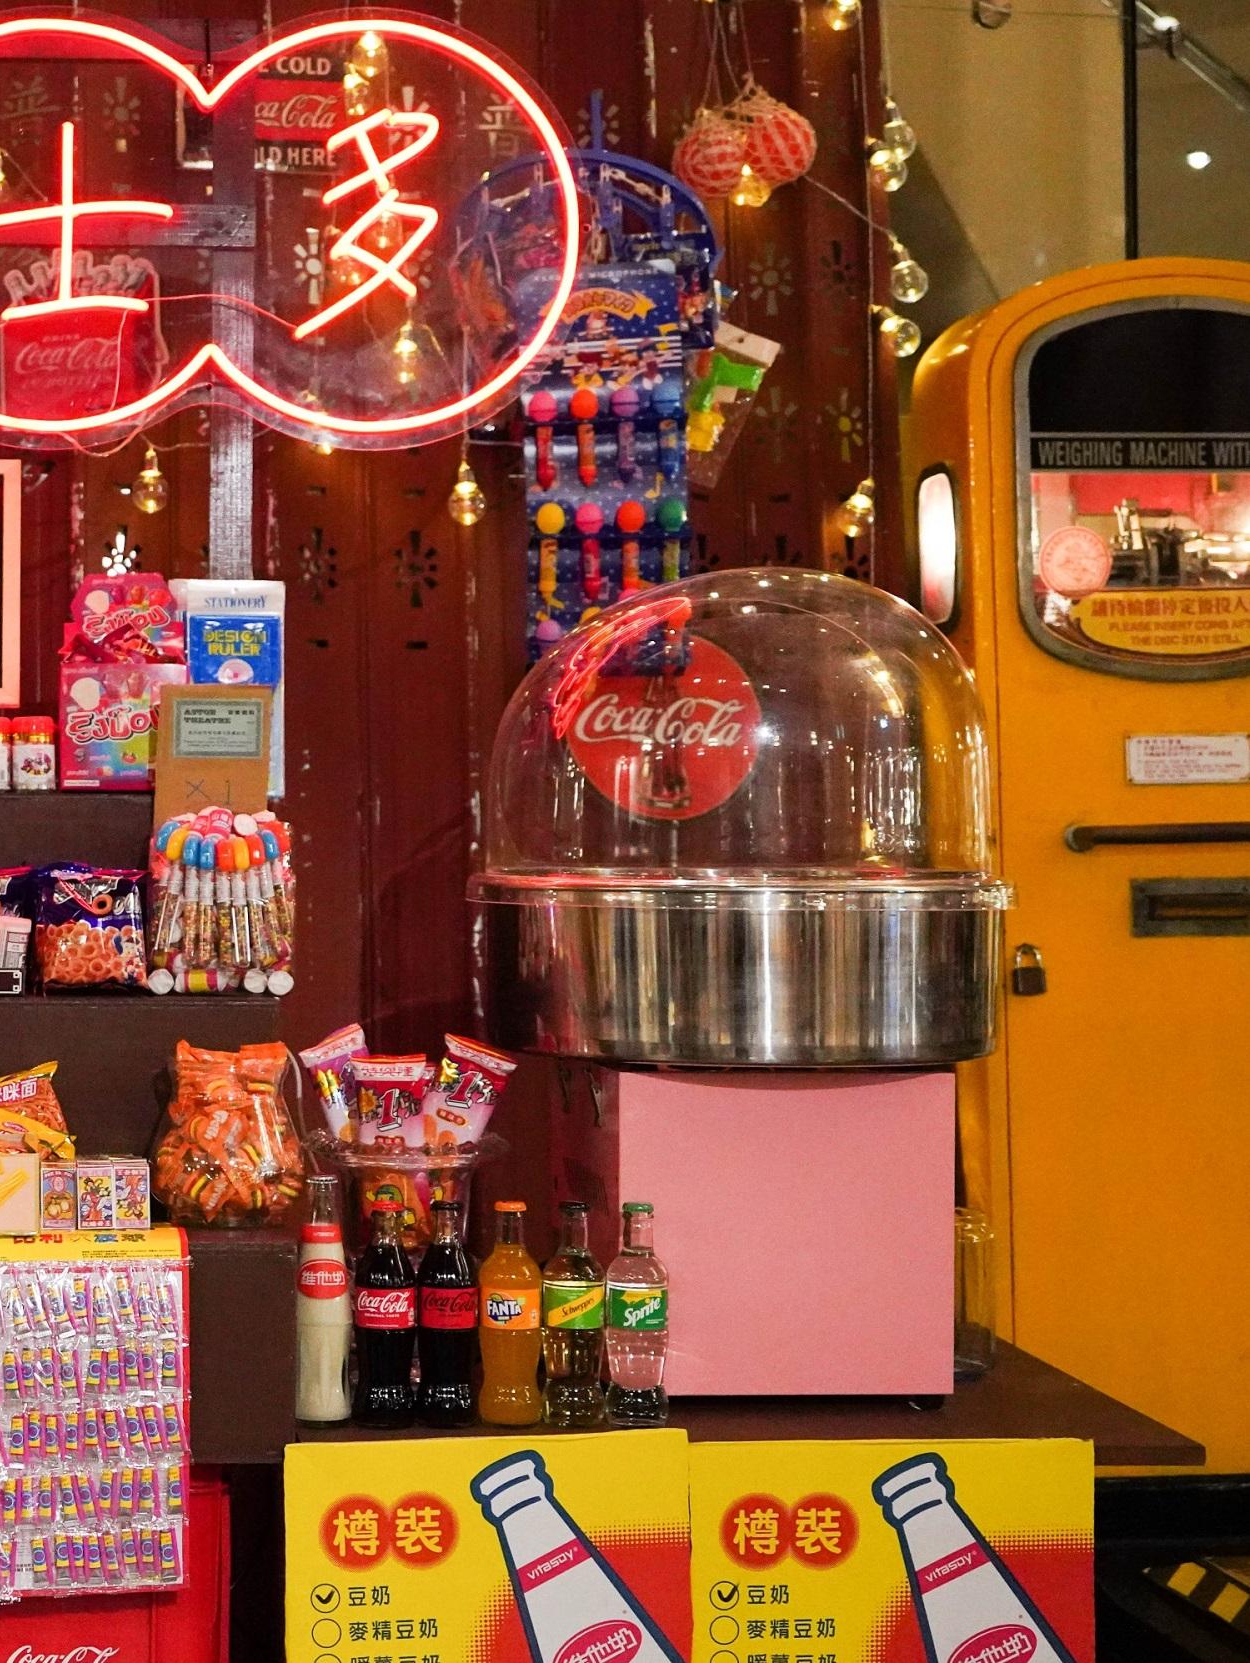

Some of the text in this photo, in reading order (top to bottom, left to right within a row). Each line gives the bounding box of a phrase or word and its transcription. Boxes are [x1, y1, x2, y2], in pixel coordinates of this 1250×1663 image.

[276, 57, 331, 75] COLD
[254, 94, 338, 128] ca-Cola
[14, 337, 119, 374] Coca-Cola
[1038, 441, 1123, 467] WEIGHING
[1130, 441, 1207, 466] MACHINE
[203, 594, 268, 609] STATIONERY
[203, 630, 269, 643] DESIGN
[207, 643, 261, 656] RULER
[574, 693, 746, 747] Coca-Cola
[357, 1290, 411, 1313] Coca-Cola
[486, 1299, 523, 1317] FANTA
[623, 1297, 663, 1327] Sprite
[332, 1507, 444, 1557] 樽裝
[733, 1507, 843, 1557] 樽裝
[526, 1550, 574, 1581] vitasoy
[925, 1553, 973, 1583] vitasoy
[347, 1585, 392, 1606] 豆奶
[746, 1585, 791, 1605] 豆奶
[348, 1618, 440, 1642] 麥精豆奶
[746, 1617, 837, 1640] 麥精豆奶
